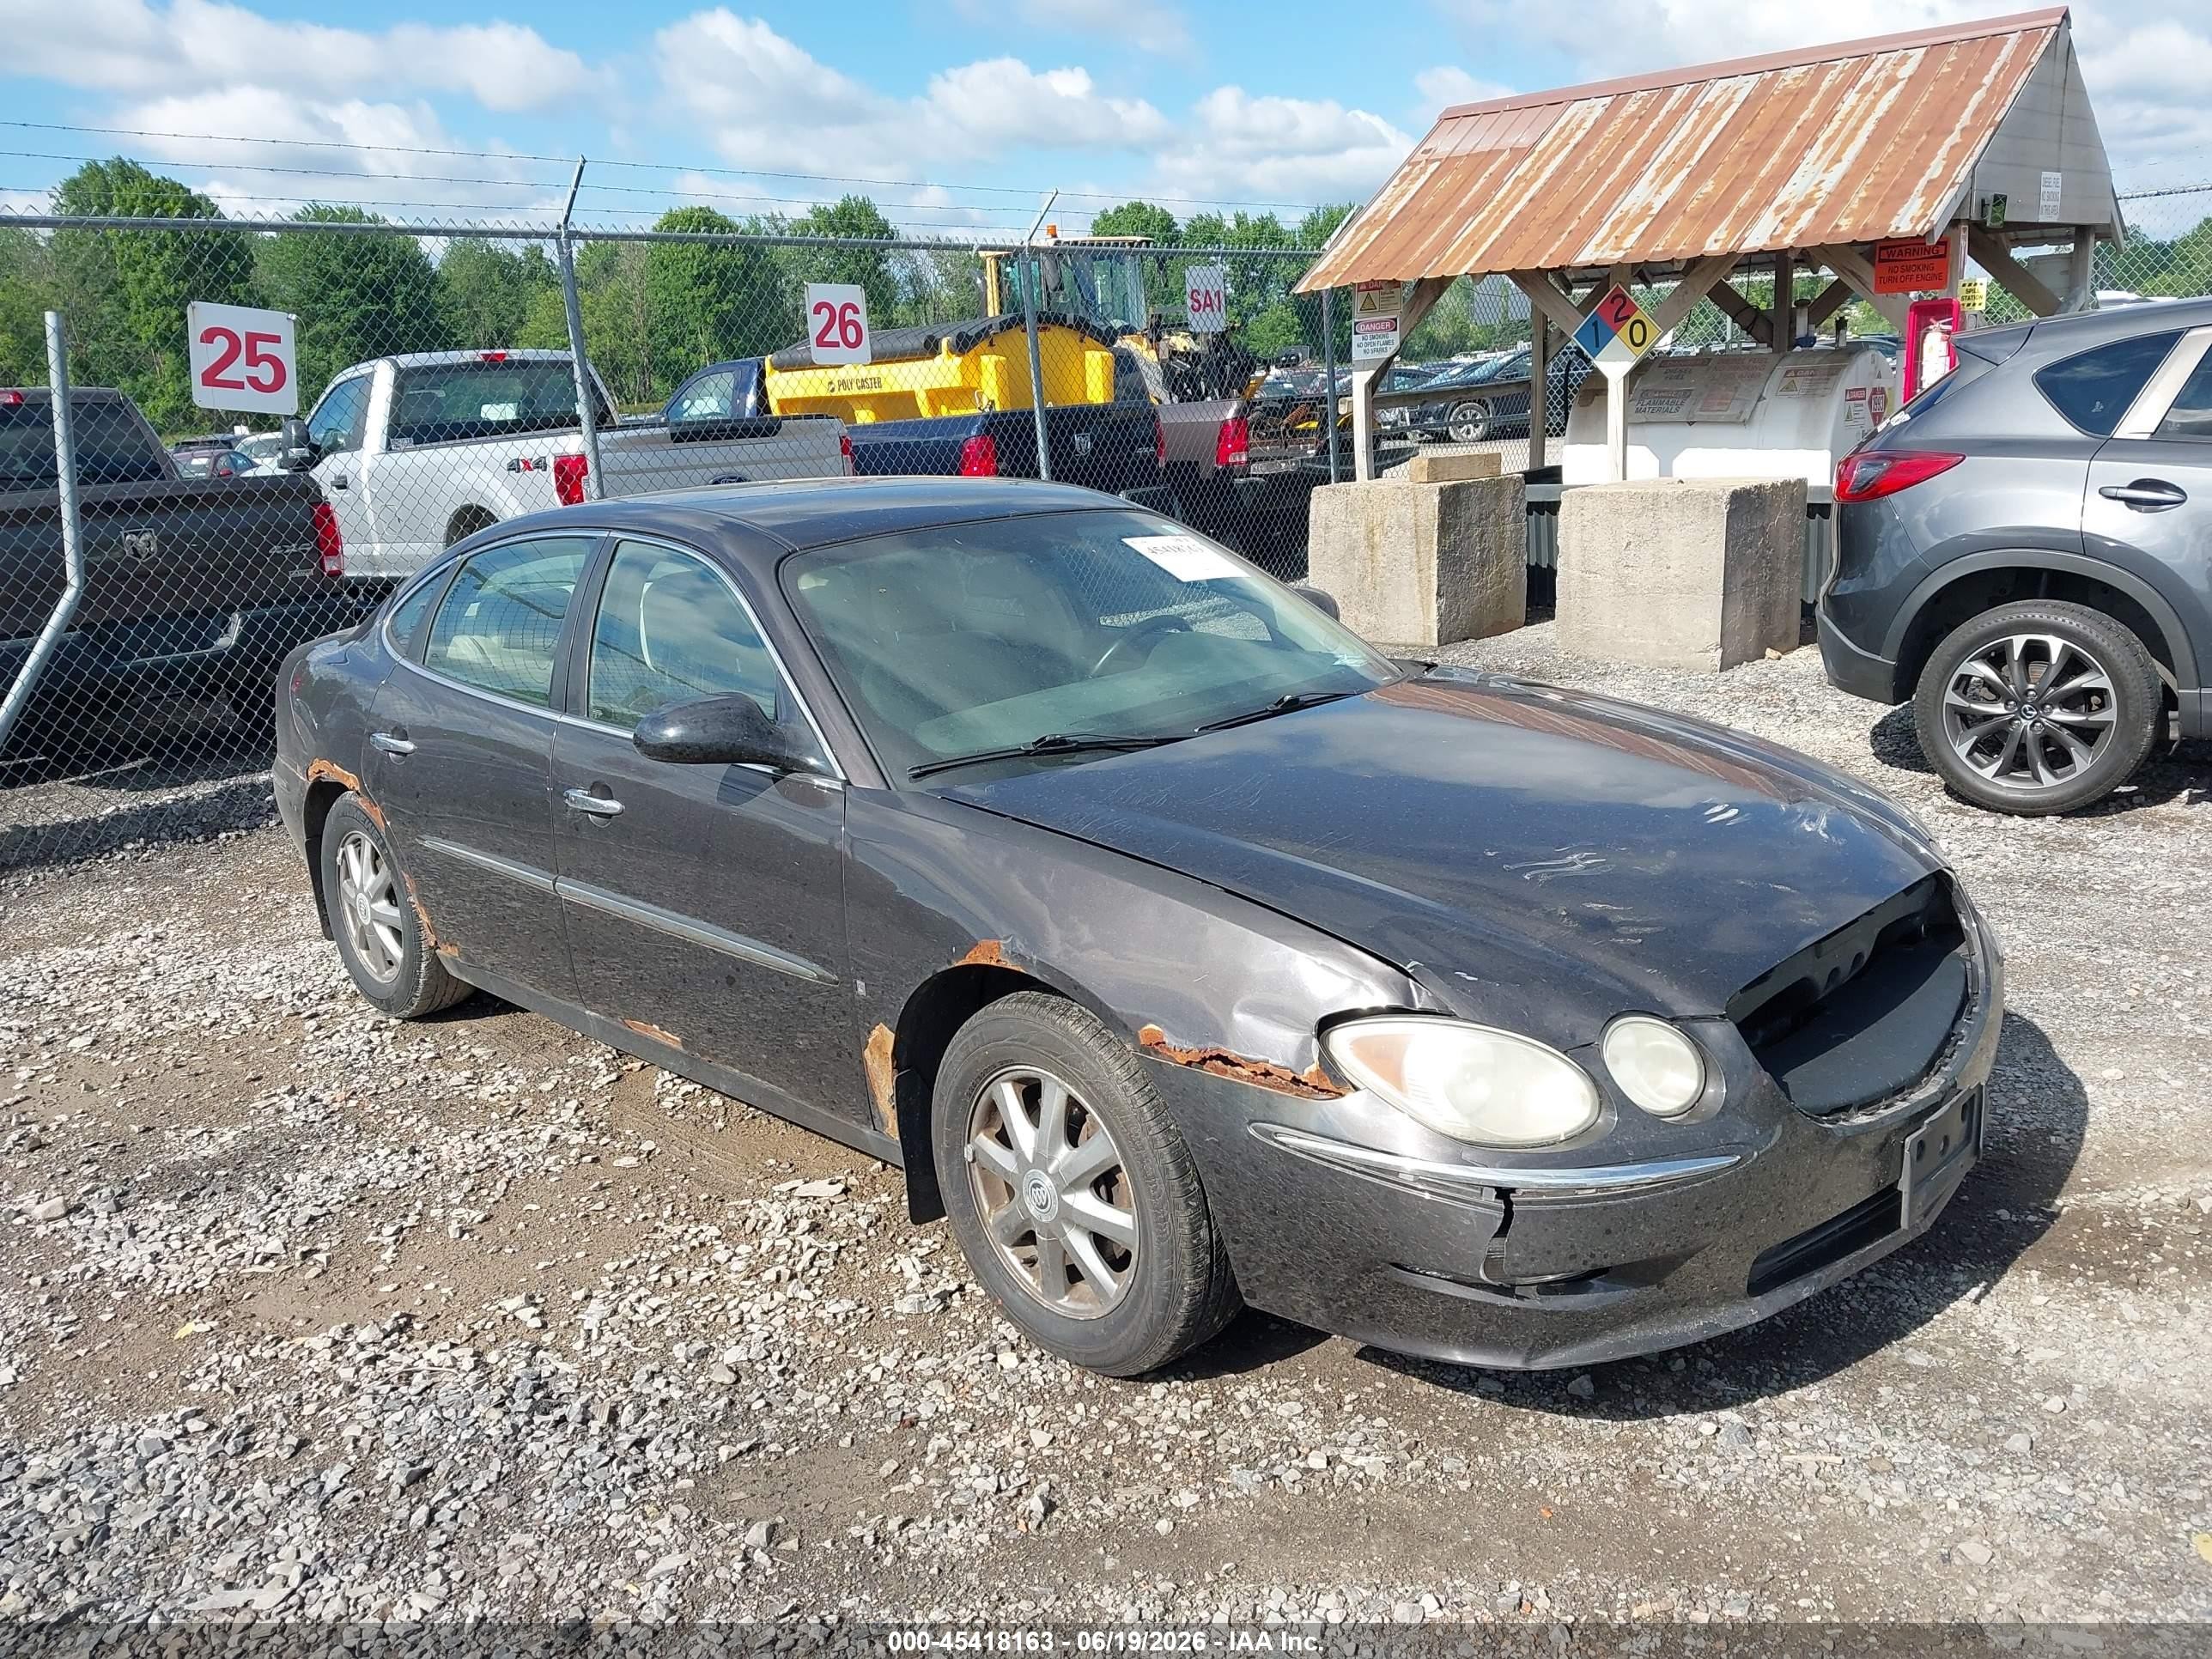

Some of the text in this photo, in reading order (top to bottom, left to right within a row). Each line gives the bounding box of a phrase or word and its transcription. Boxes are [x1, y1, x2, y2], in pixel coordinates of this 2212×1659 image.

[1887, 245, 1940, 258] WARNING
[1888, 262, 1935, 274] NO SMOKING
[1879, 272, 1944, 285] TURN OFF ENGINE
[1190, 288, 1223, 313] SA1
[1610, 294, 1632, 324] 2
[812, 301, 864, 349] 26
[1359, 321, 1392, 332] DANGER
[1591, 319, 1648, 349] 1 0
[199, 327, 287, 393] 25
[855, 376, 883, 391] CASTER
[507, 456, 548, 473] 4X4
